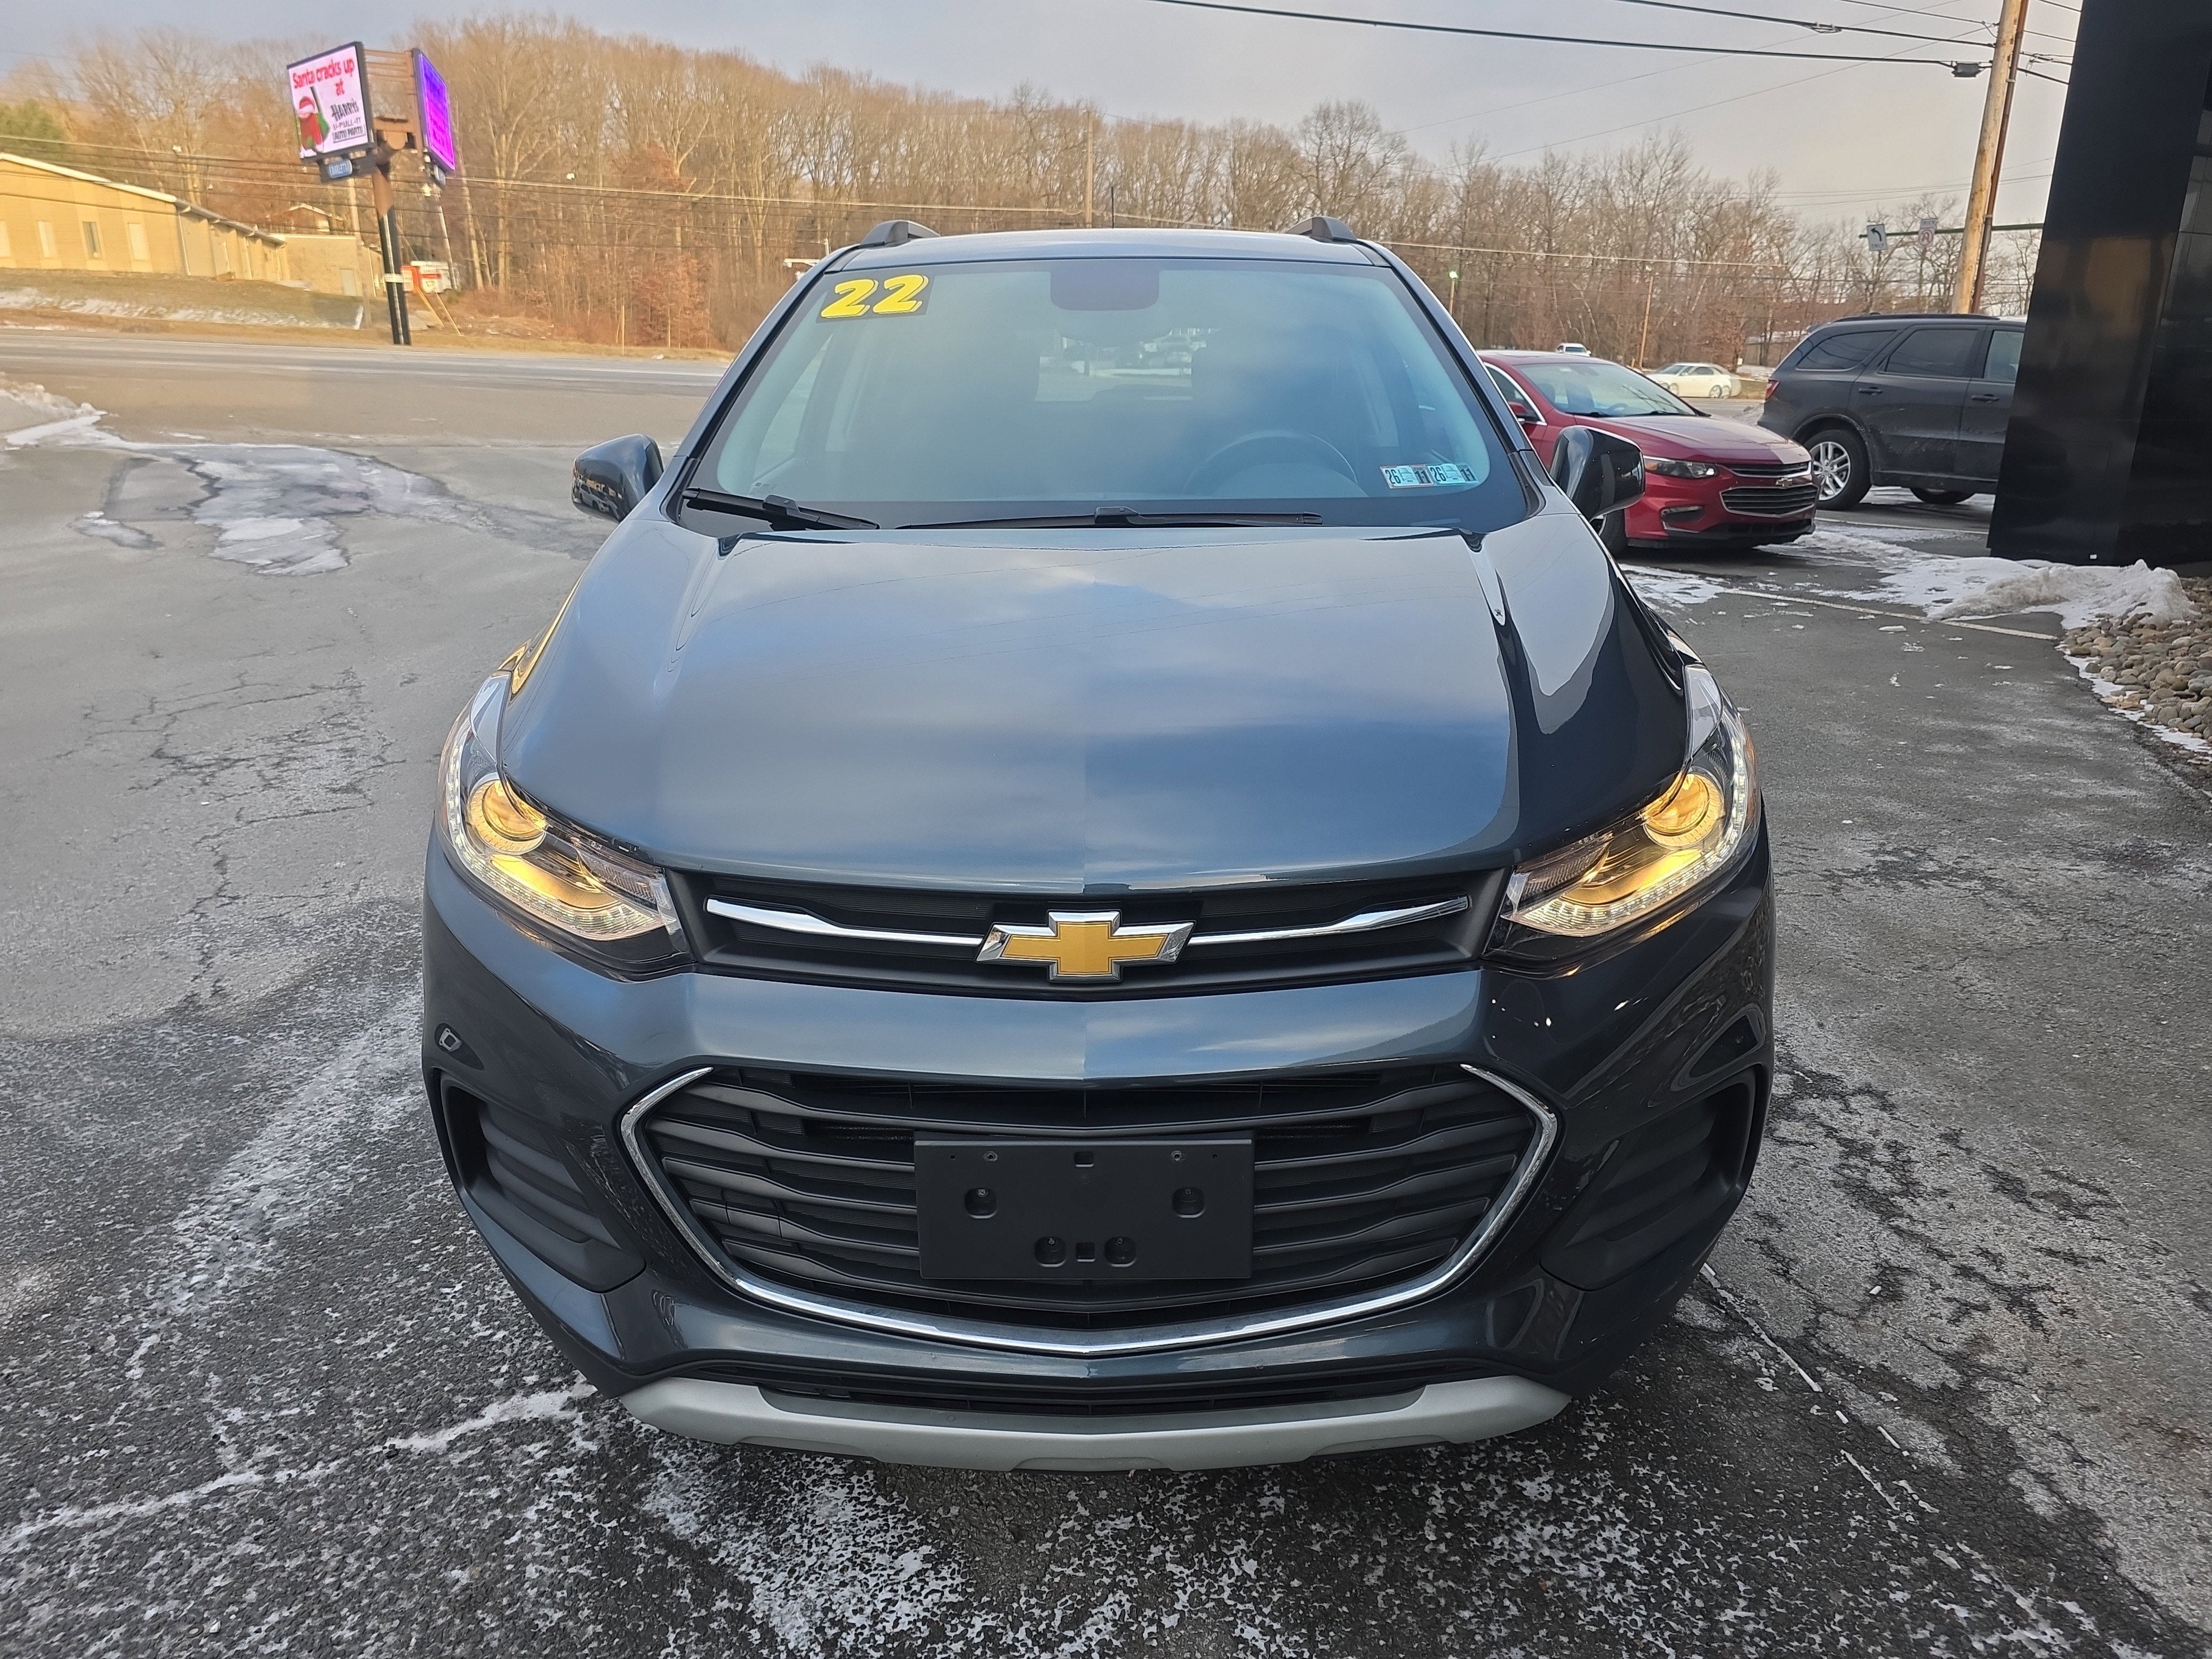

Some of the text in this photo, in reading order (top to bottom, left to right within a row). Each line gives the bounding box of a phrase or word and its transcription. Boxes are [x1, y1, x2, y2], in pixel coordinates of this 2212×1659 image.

[292, 59, 355, 88] Santa cracks up
[335, 78, 345, 96] at
[335, 129, 347, 140] AUTO
[821, 274, 929, 318] 22
[1385, 469, 1401, 484] 26
[1414, 470, 1432, 484] 11
[1430, 467, 1446, 482] 26
[1460, 468, 1476, 481] 11
